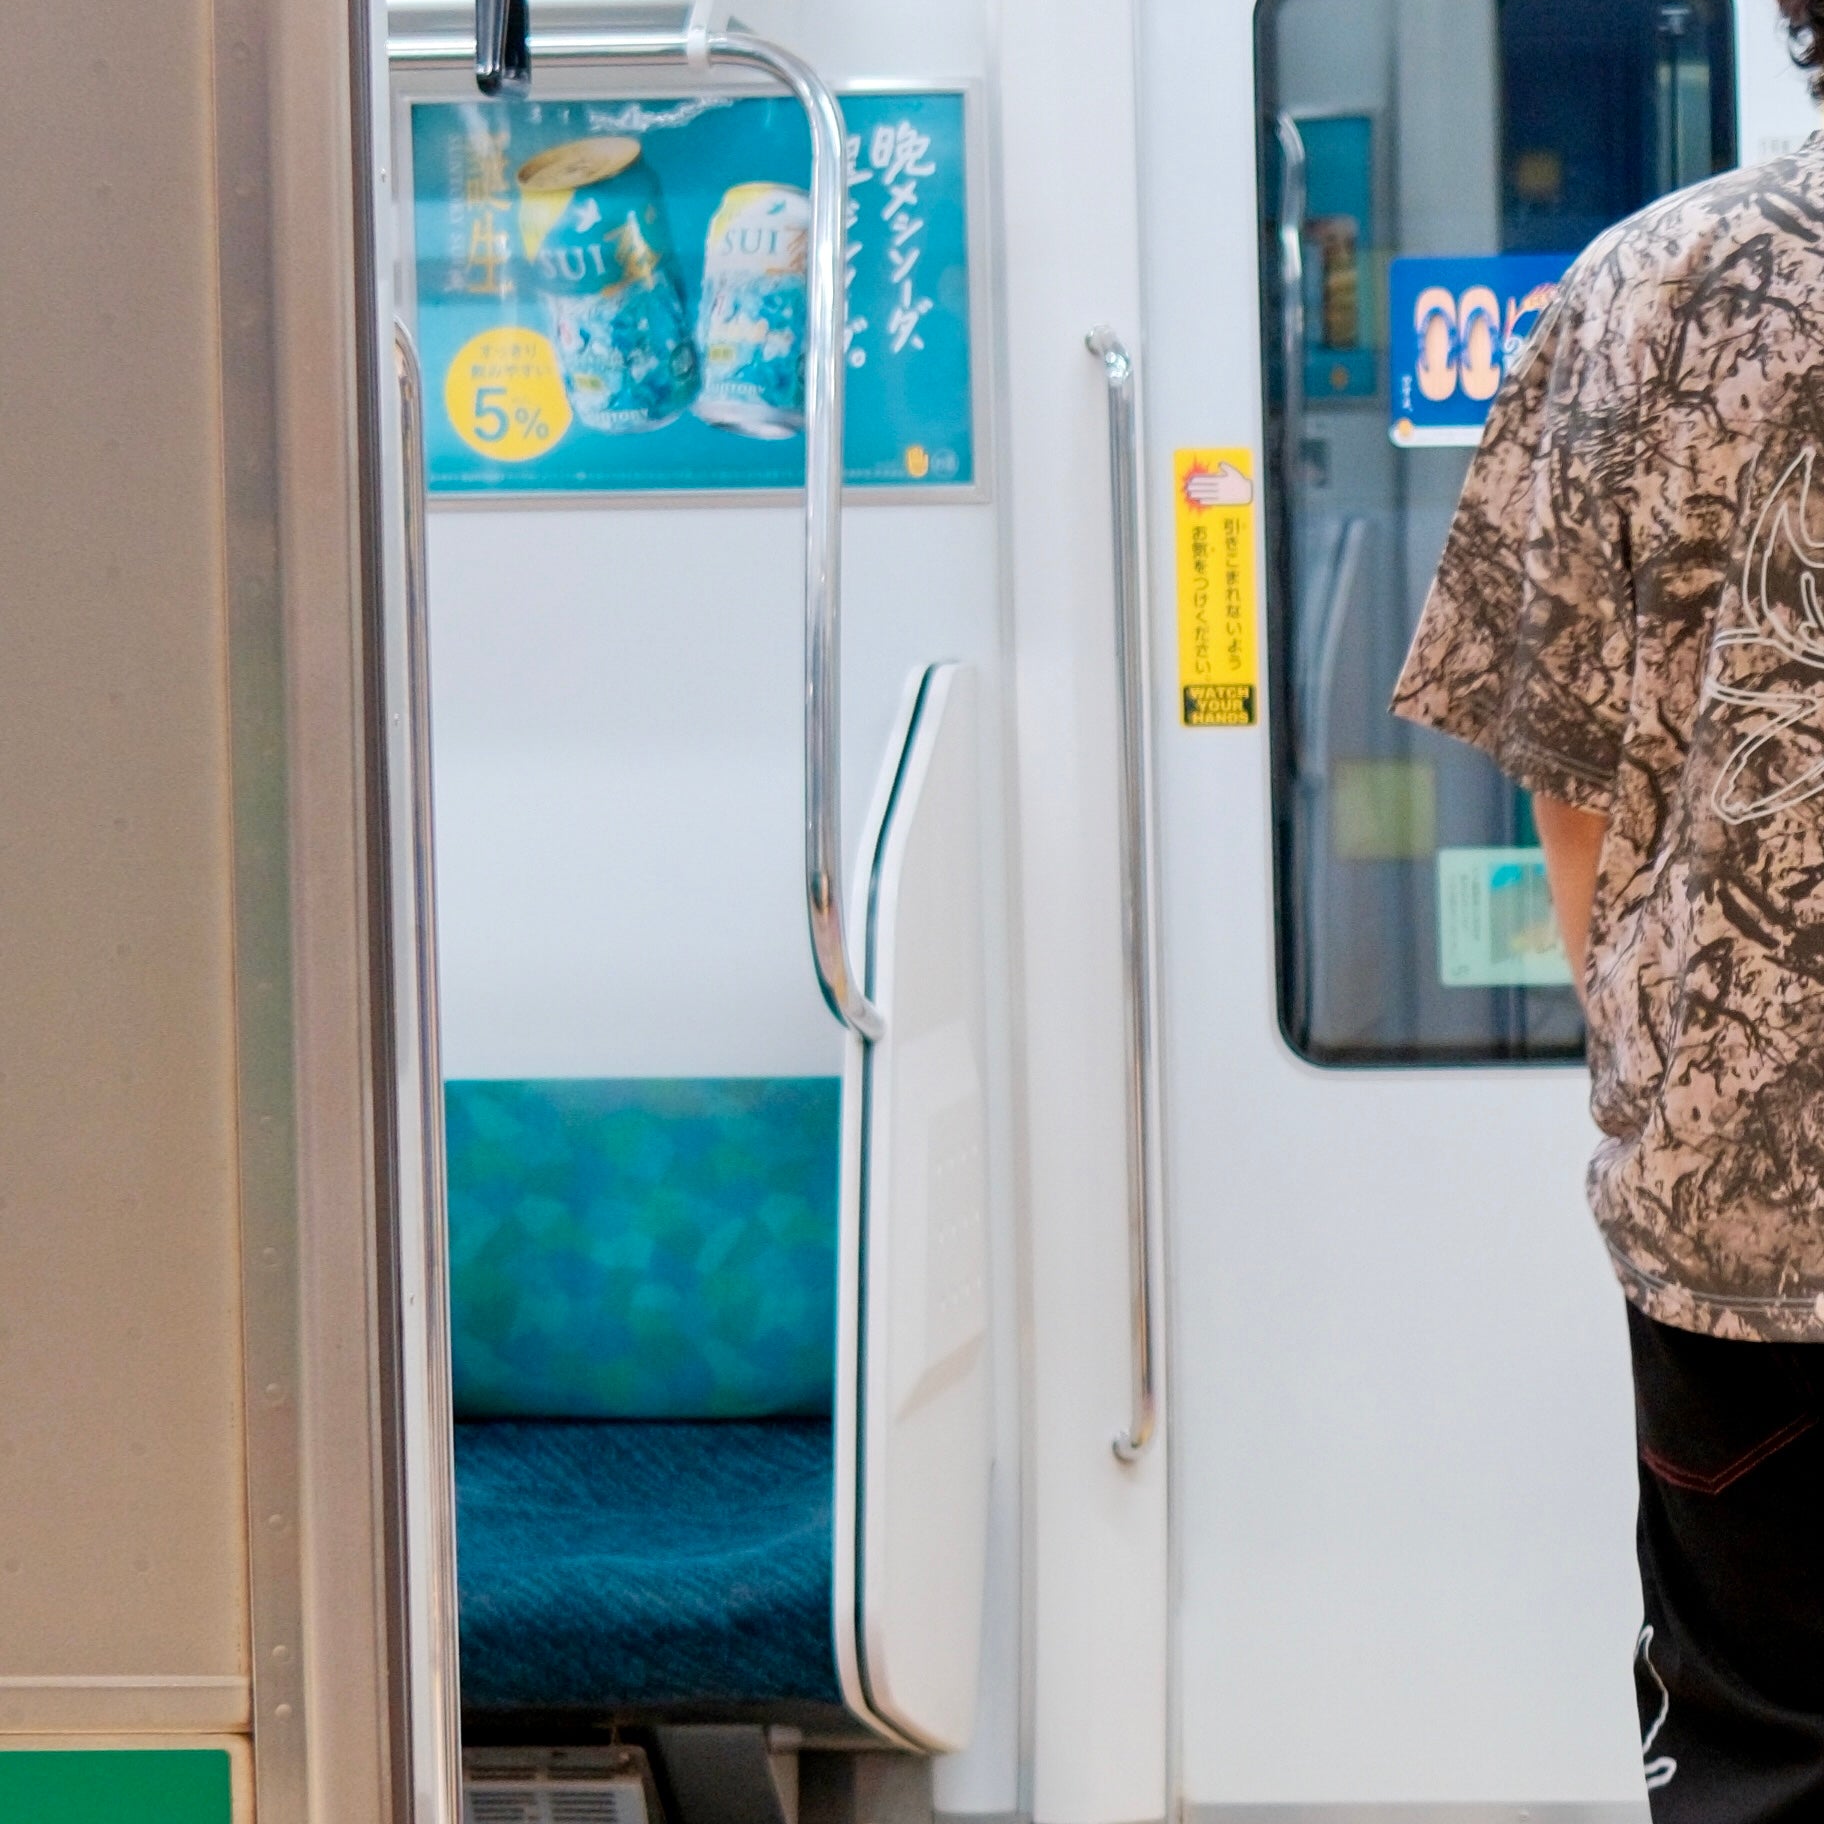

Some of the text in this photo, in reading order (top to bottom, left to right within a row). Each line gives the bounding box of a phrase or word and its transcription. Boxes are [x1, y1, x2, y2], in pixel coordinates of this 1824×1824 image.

[722, 228, 780, 256] SUI
[540, 243, 606, 281] SUI
[474, 386, 550, 443] 5%
[1190, 687, 1249, 699] WATCH
[1198, 699, 1242, 712] YOUR
[1192, 712, 1249, 725] HANDS
